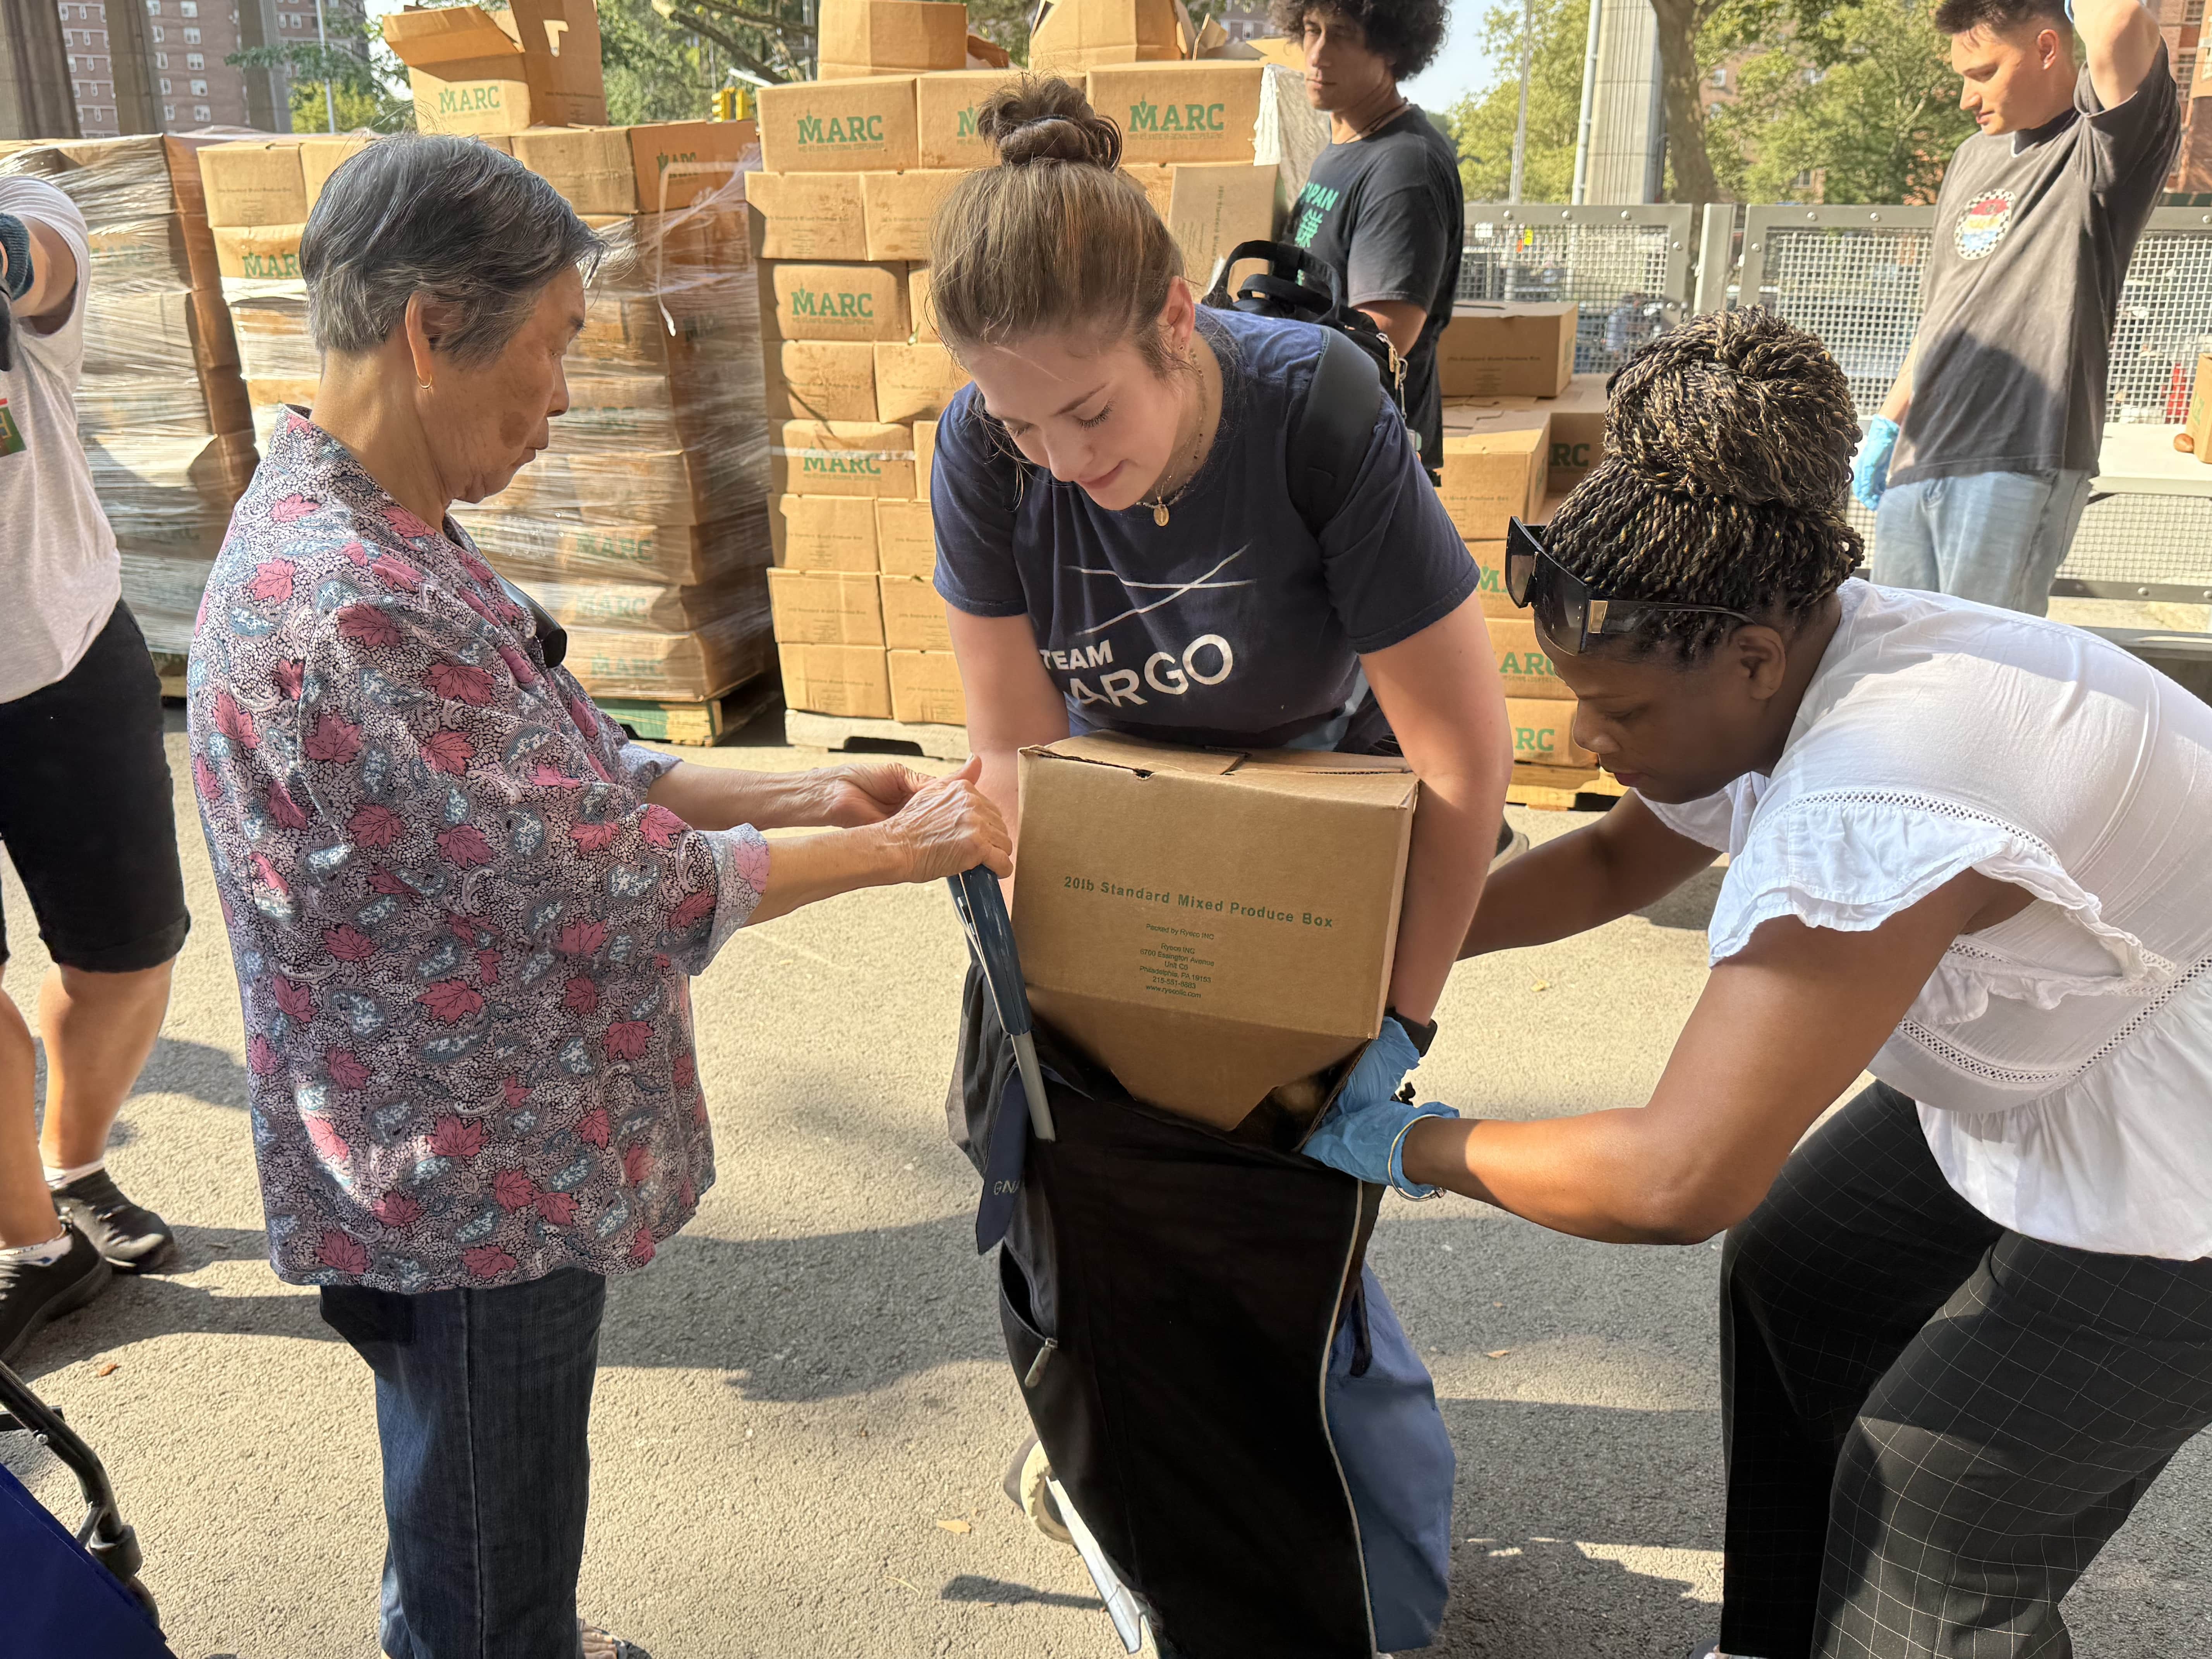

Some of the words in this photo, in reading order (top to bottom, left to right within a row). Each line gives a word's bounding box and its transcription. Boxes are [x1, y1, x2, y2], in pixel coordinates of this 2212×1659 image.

[438, 87, 500, 114] MARC
[797, 115, 884, 144] MARC
[1128, 101, 1225, 132] MARC
[242, 252, 300, 279] MAR
[791, 289, 874, 318] MARC
[1551, 444, 1590, 467] RC
[1039, 638, 1113, 670] TEAM
[1070, 634, 1233, 707] ARGO
[1515, 727, 1554, 752] RC
[1064, 876, 1094, 891] 20lb
[1101, 881, 1170, 904] Standard
[1178, 894, 1223, 912] Mixed
[1230, 902, 1294, 922] Produce
[1302, 912, 1333, 928] Box
[1146, 924, 1170, 933] Packed
[1140, 966, 1179, 979] Philadelphia,
[1158, 951, 1188, 962] Essington
[1190, 957, 1214, 967] Avenue
[1164, 961, 1177, 969] Unit
